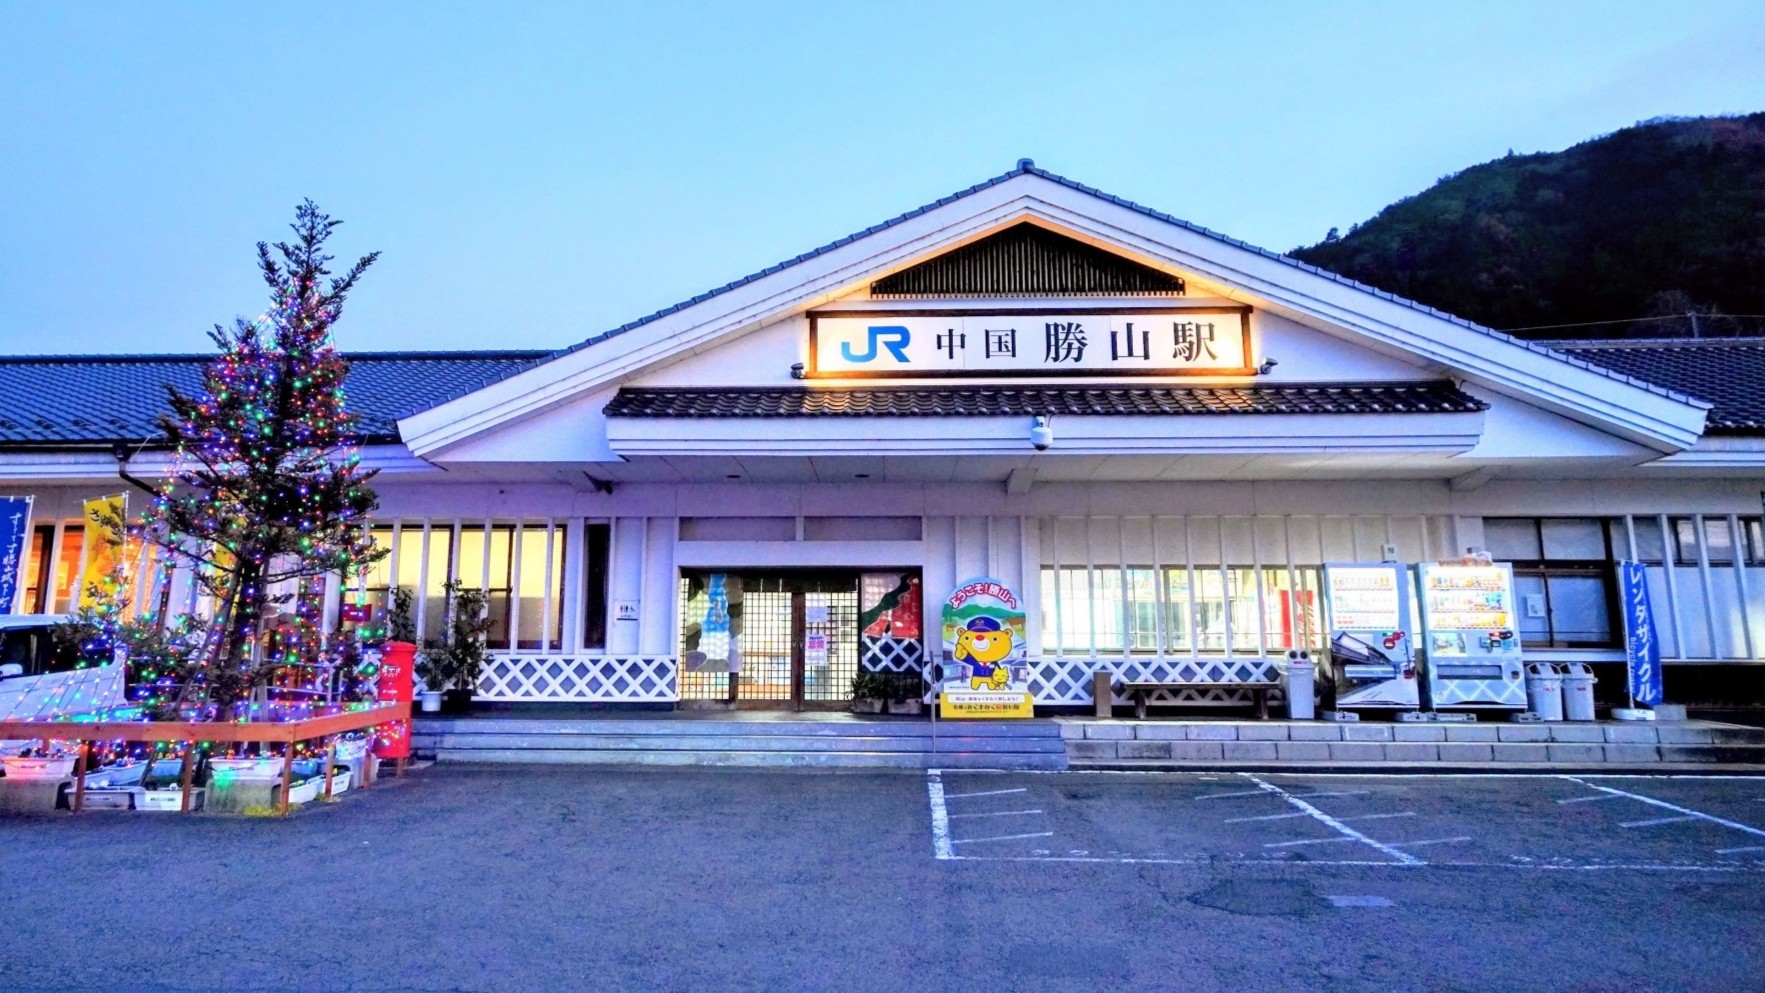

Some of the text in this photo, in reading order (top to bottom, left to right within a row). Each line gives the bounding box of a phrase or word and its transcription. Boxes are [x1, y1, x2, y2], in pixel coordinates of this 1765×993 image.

[840, 325, 911, 363] JR
[935, 320, 1218, 363] 中国勝山駅
[1629, 566, 1657, 702] レンタサイクル
